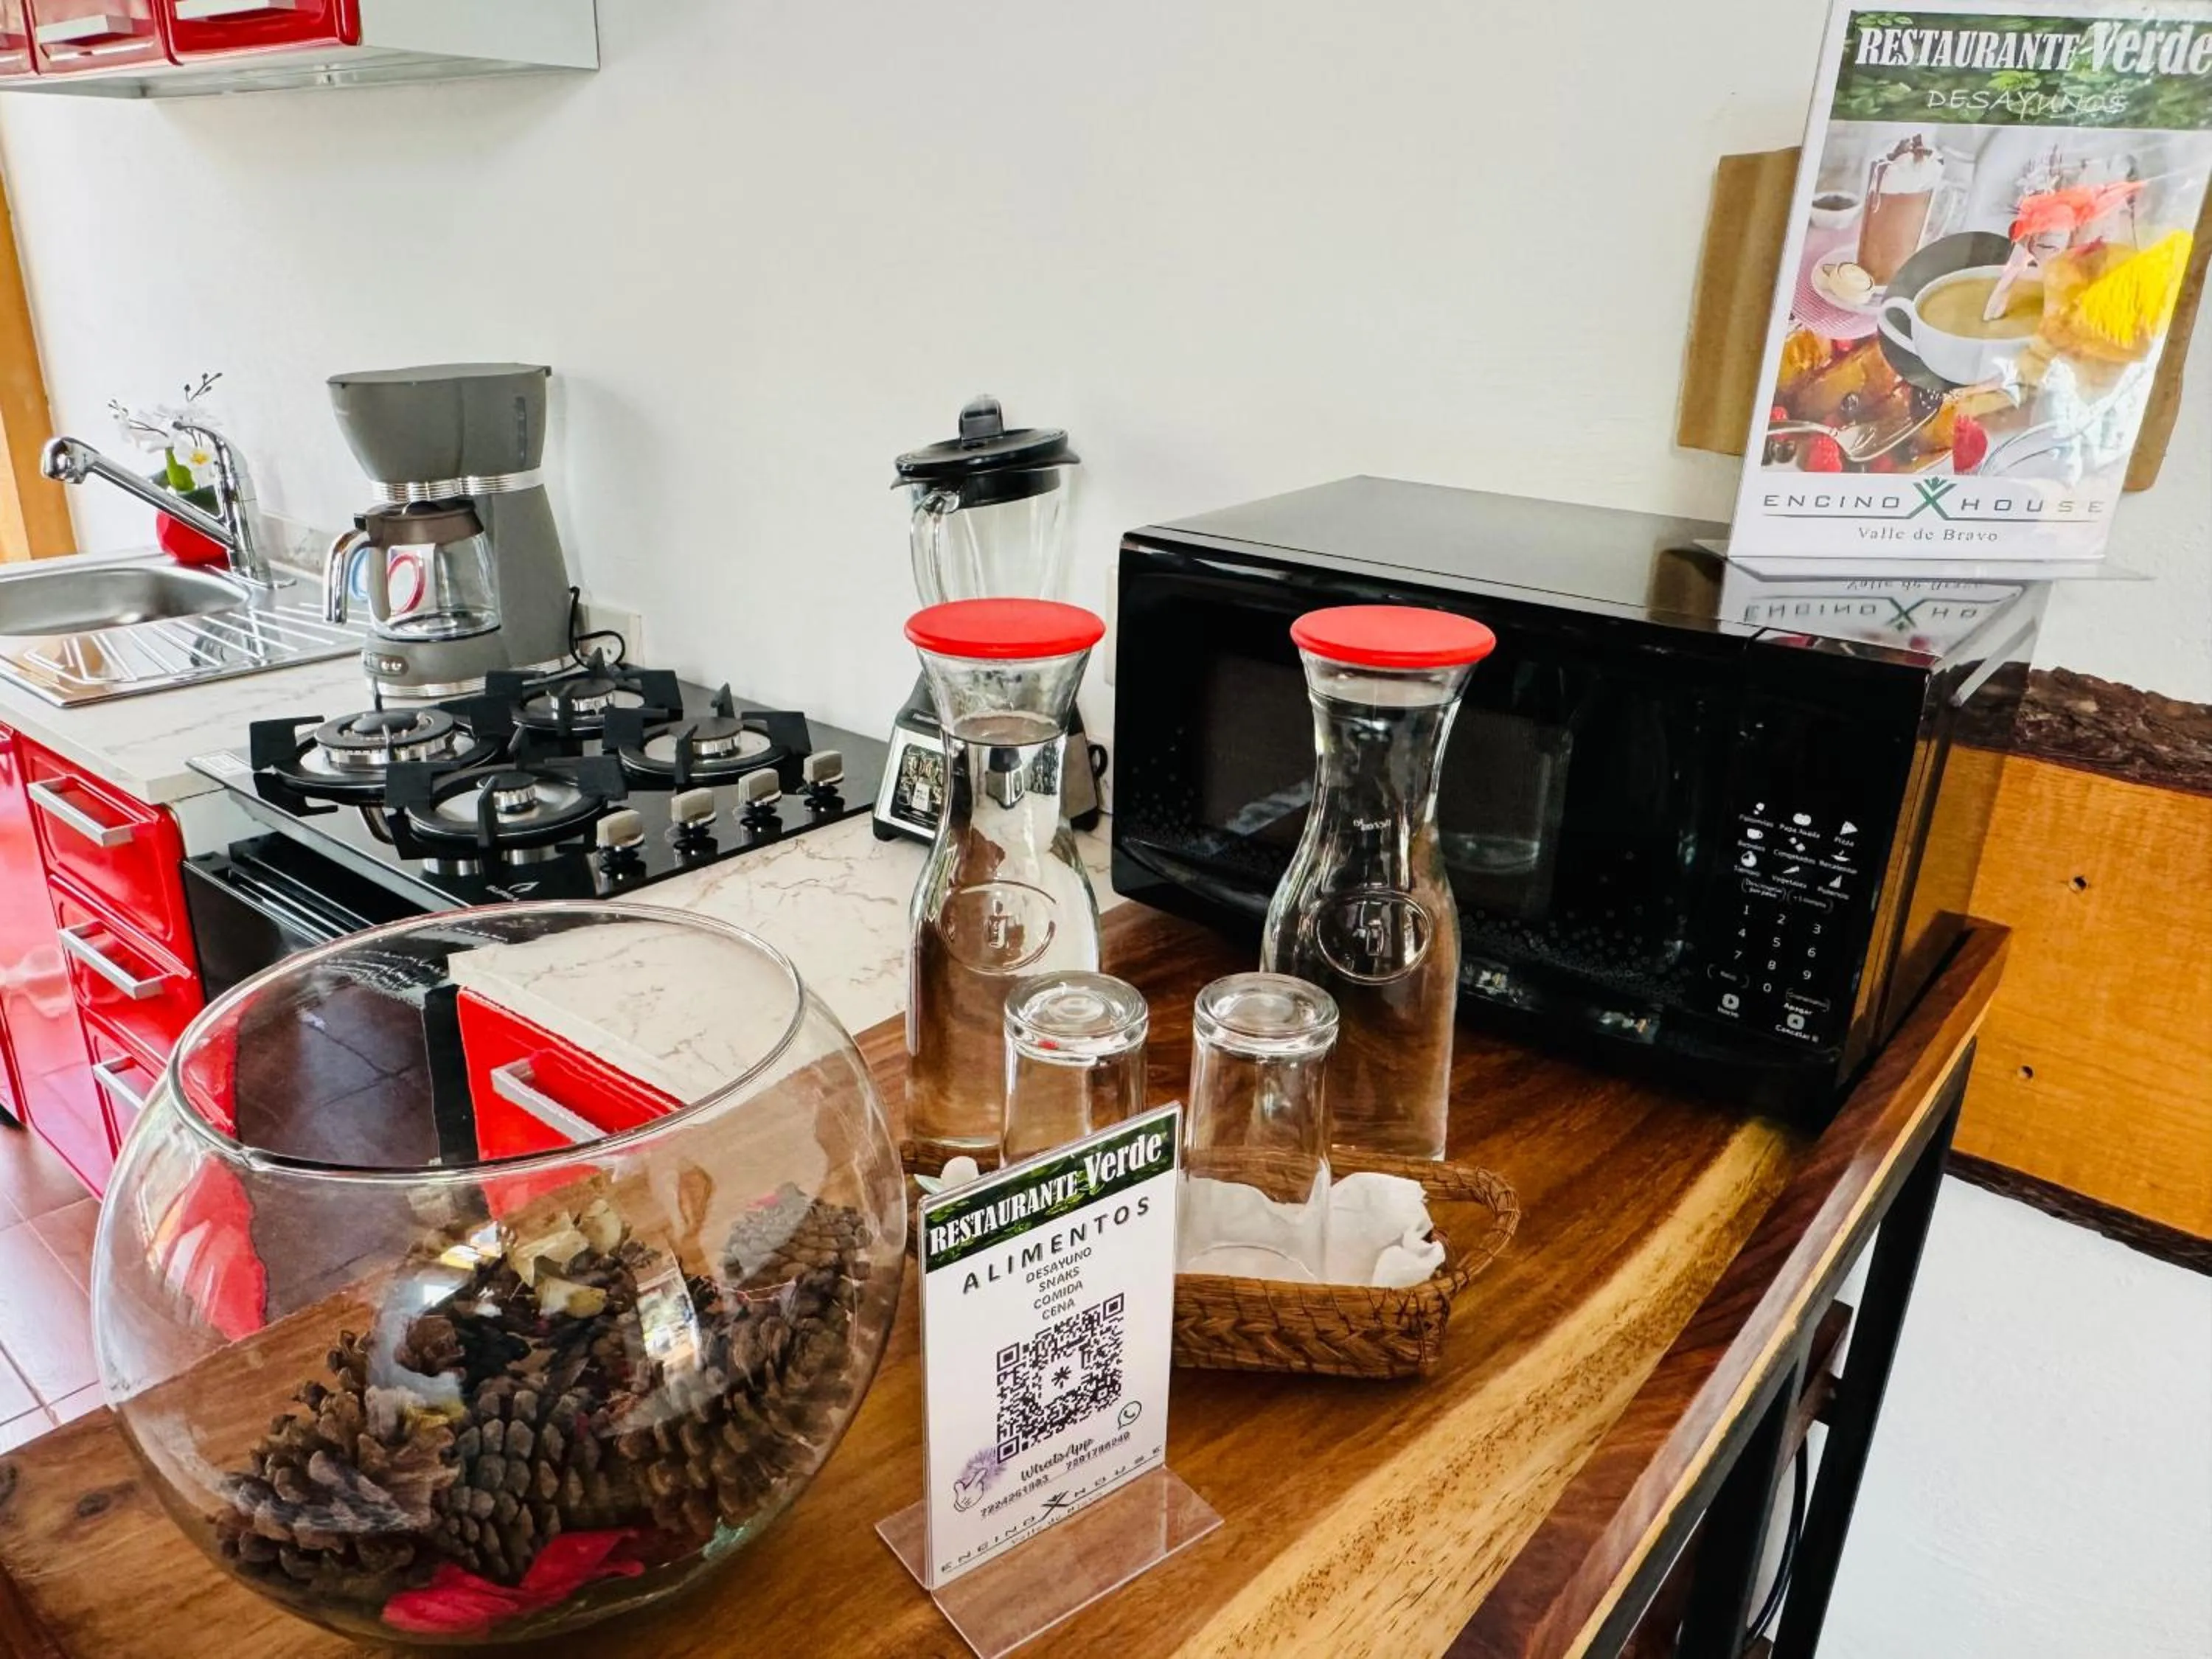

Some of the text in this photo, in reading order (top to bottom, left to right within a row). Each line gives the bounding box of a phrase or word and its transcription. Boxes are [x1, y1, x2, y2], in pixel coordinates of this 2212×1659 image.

[1855, 21, 2212, 74] RESTAURANTE Verde
[1763, 495, 2105, 513] ENCINO HOUSE
[1858, 526, 1998, 543] Valle de Bravo
[1742, 904, 1750, 916] 1
[1777, 914, 1787, 925] 2
[1738, 928, 1747, 939] 4
[1812, 924, 1821, 935] 3
[1772, 937, 1781, 948] 5
[1734, 950, 1742, 960] 7
[1807, 947, 1816, 958] 6
[1767, 960, 1776, 970] 8
[1802, 970, 1812, 981] 9
[1762, 983, 1772, 993] 0
[929, 1133, 1162, 1255] RESTAURANTE Verde
[963, 1197, 1151, 1295] ALIMENTOS
[1026, 1246, 1093, 1284] DESAYUNO
[1038, 1266, 1081, 1293] SNAKS
[1033, 1280, 1084, 1310] COMIDA
[1042, 1298, 1075, 1321] CENA
[1020, 1438, 1095, 1481] WhatsApp
